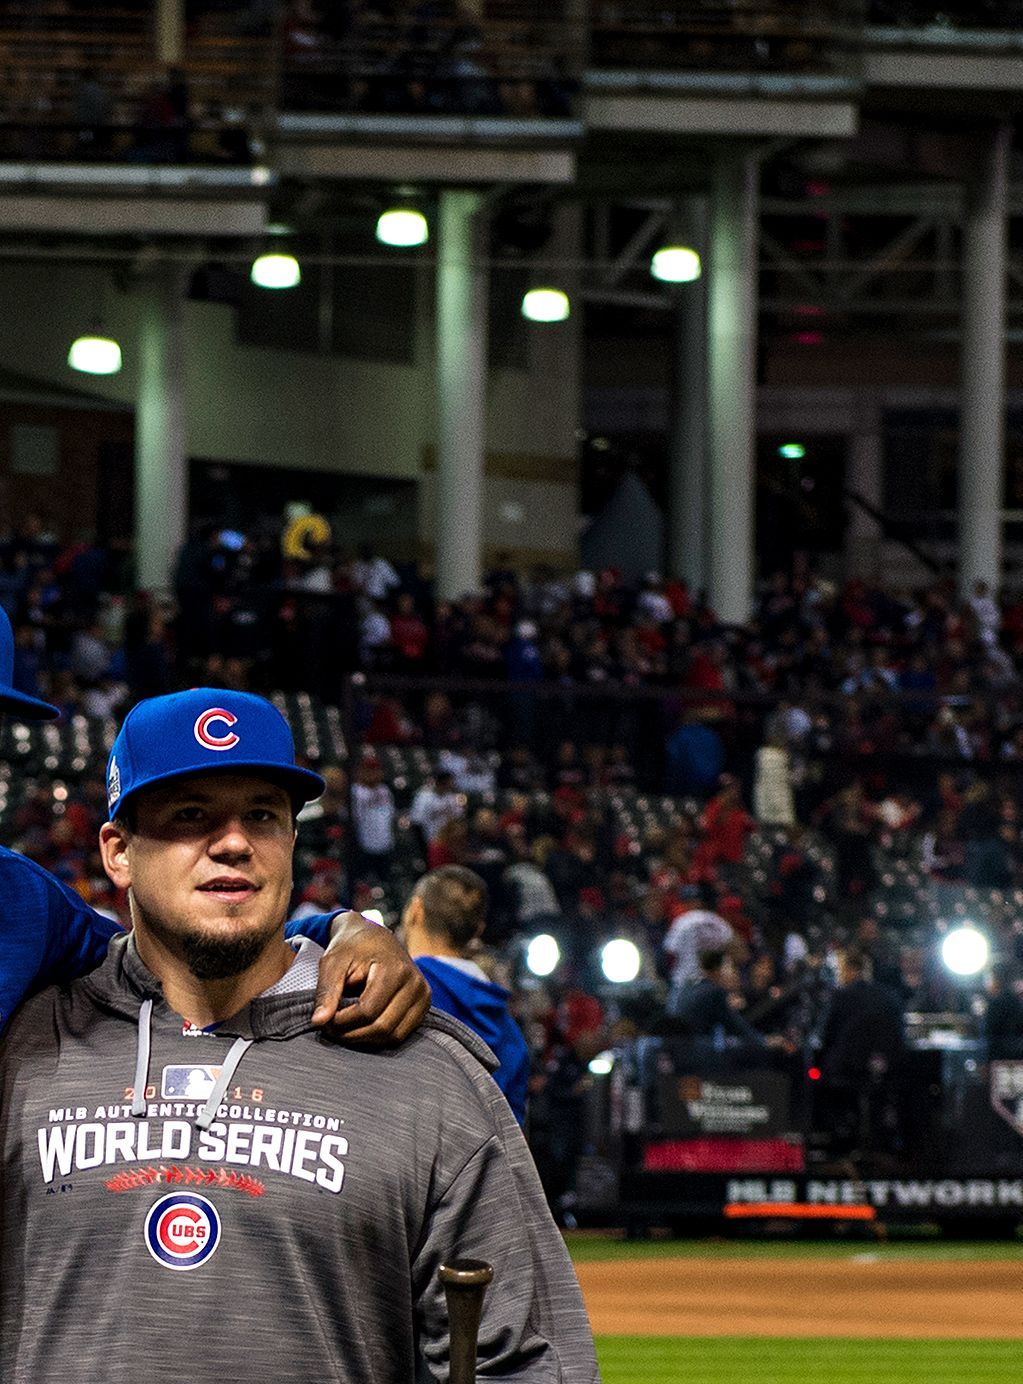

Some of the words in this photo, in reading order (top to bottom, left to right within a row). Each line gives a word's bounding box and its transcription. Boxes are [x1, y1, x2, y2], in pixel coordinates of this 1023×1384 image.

[194, 707, 240, 751] C
[48, 1106, 87, 1123] MLB
[94, 1102, 208, 1119] AUTENTIC
[216, 1103, 340, 1131] COLLECTION
[37, 1120, 191, 1184] WORLD
[198, 1121, 350, 1194] SERIES
[805, 1179, 1023, 1206] NETWORK
[160, 1207, 206, 1255] CUBS
